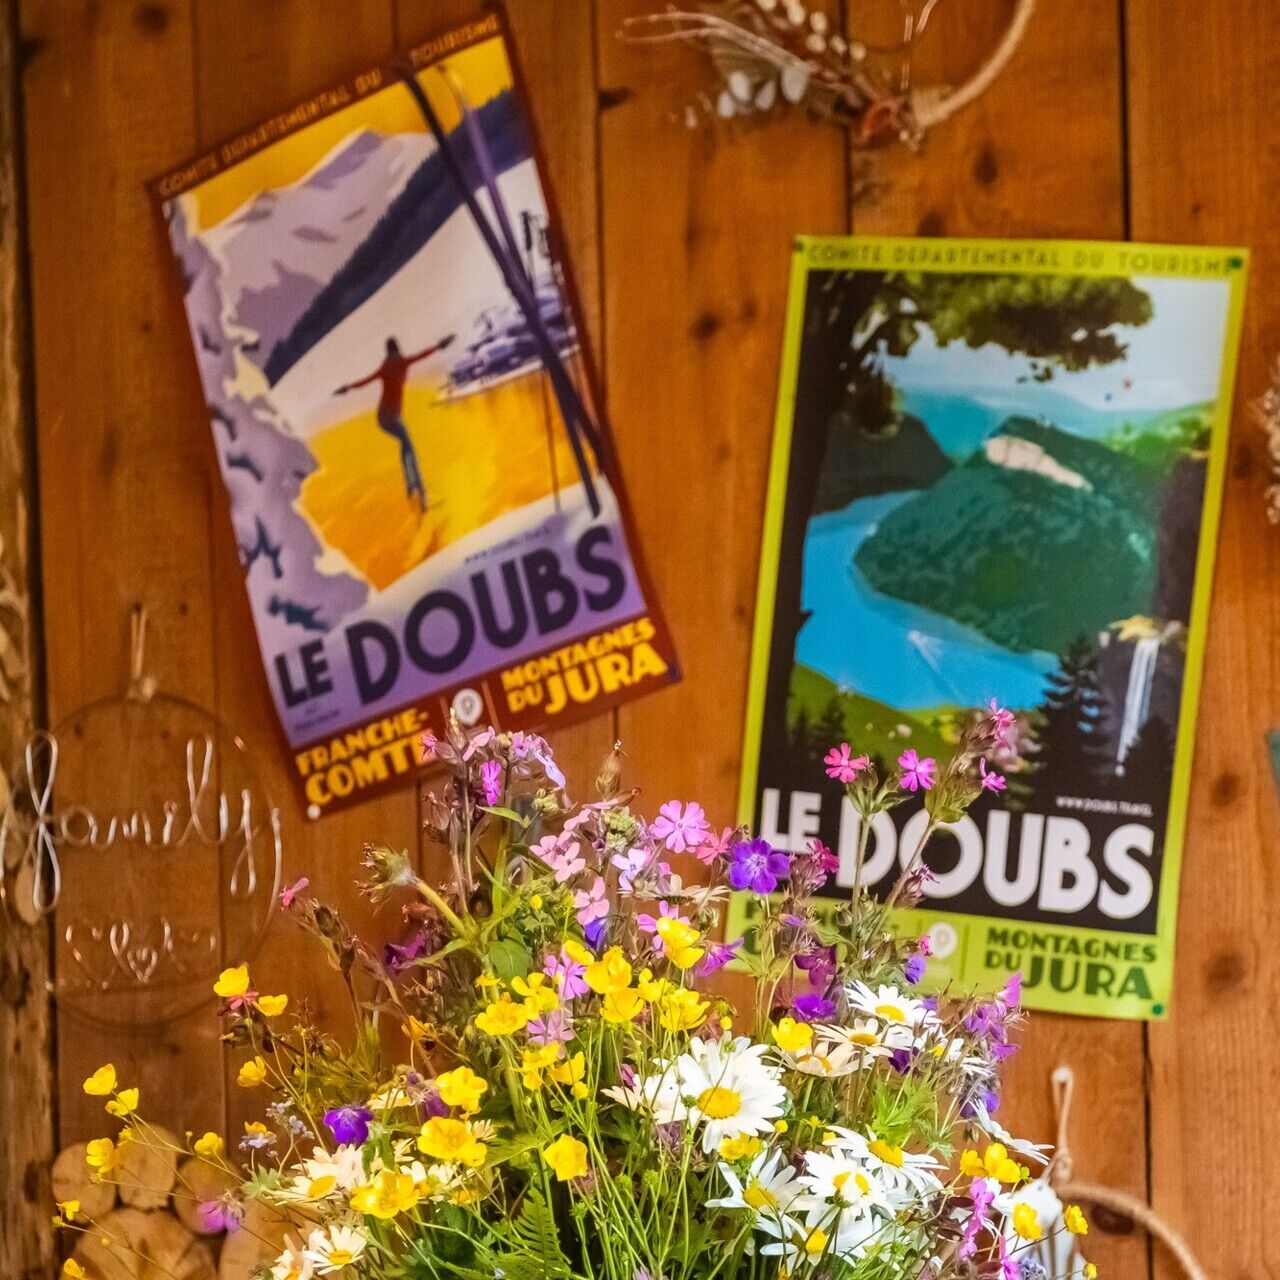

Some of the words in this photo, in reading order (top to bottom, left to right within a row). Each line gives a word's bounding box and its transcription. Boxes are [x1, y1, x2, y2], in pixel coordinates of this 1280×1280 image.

[1072, 250, 1104, 269] DU
[274, 636, 334, 708] LE
[345, 525, 627, 707] DOUBS
[501, 617, 657, 693] MONTAGNES
[507, 683, 545, 714] DU
[544, 641, 669, 715] JURA
[295, 708, 430, 776] FRANCHE-
[760, 787, 823, 856] LE
[836, 796, 1156, 921] DOUBS
[984, 950, 1022, 973] DU
[1019, 955, 1154, 1001] JURA
[985, 926, 1158, 964] MONTAGNES
